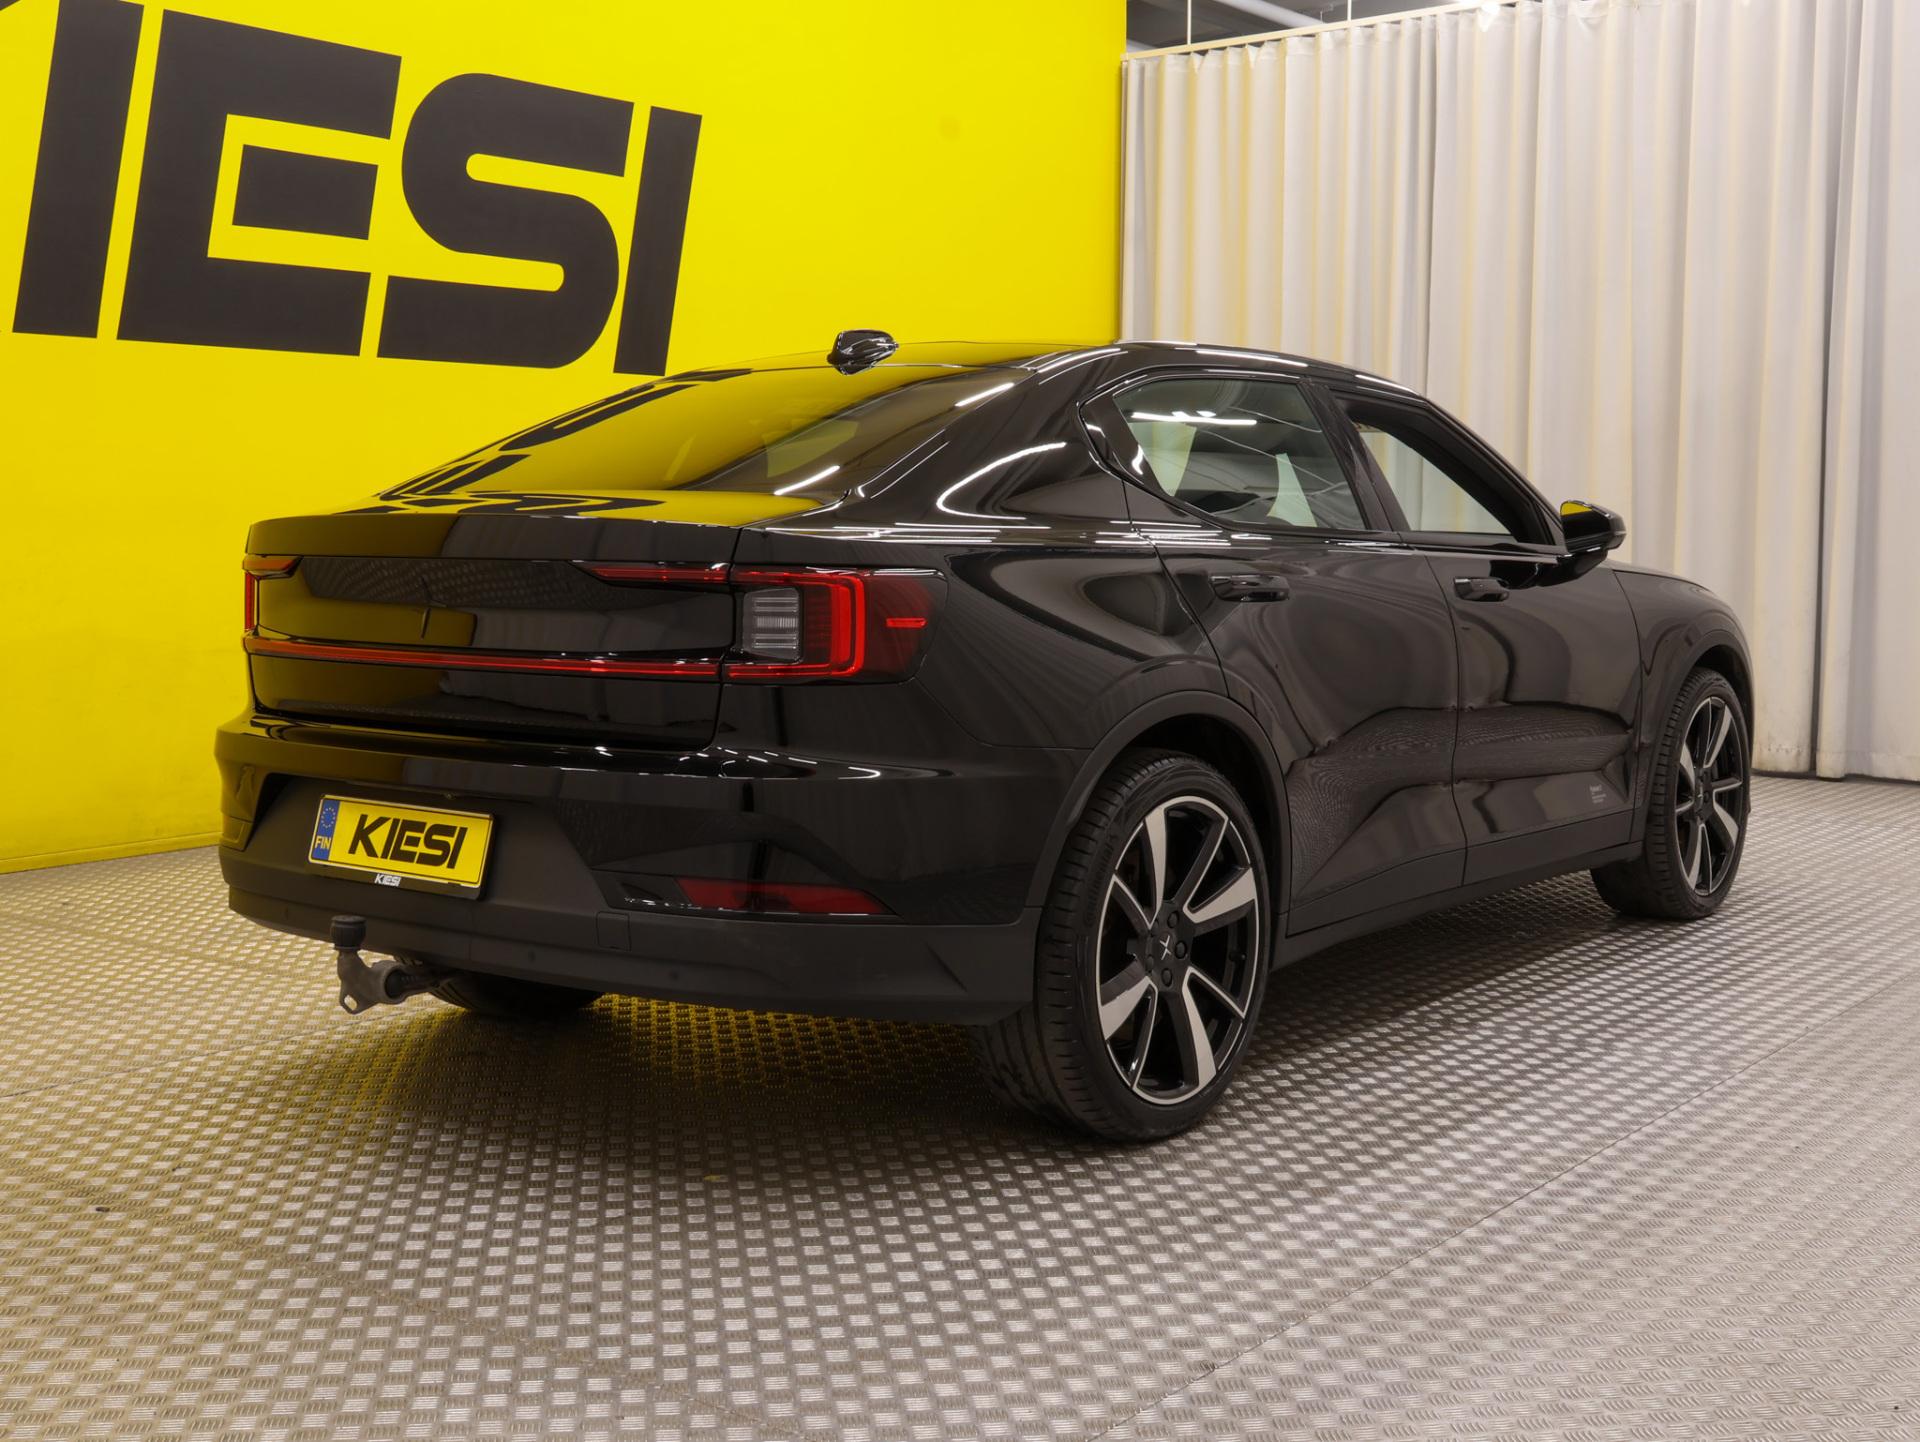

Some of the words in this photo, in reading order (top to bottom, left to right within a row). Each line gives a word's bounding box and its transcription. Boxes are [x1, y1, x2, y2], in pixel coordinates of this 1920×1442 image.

[0, 0, 702, 376] IESI
[315, 835, 332, 851] FIN
[348, 814, 468, 869] KIESI
[374, 873, 401, 887] KIESI
